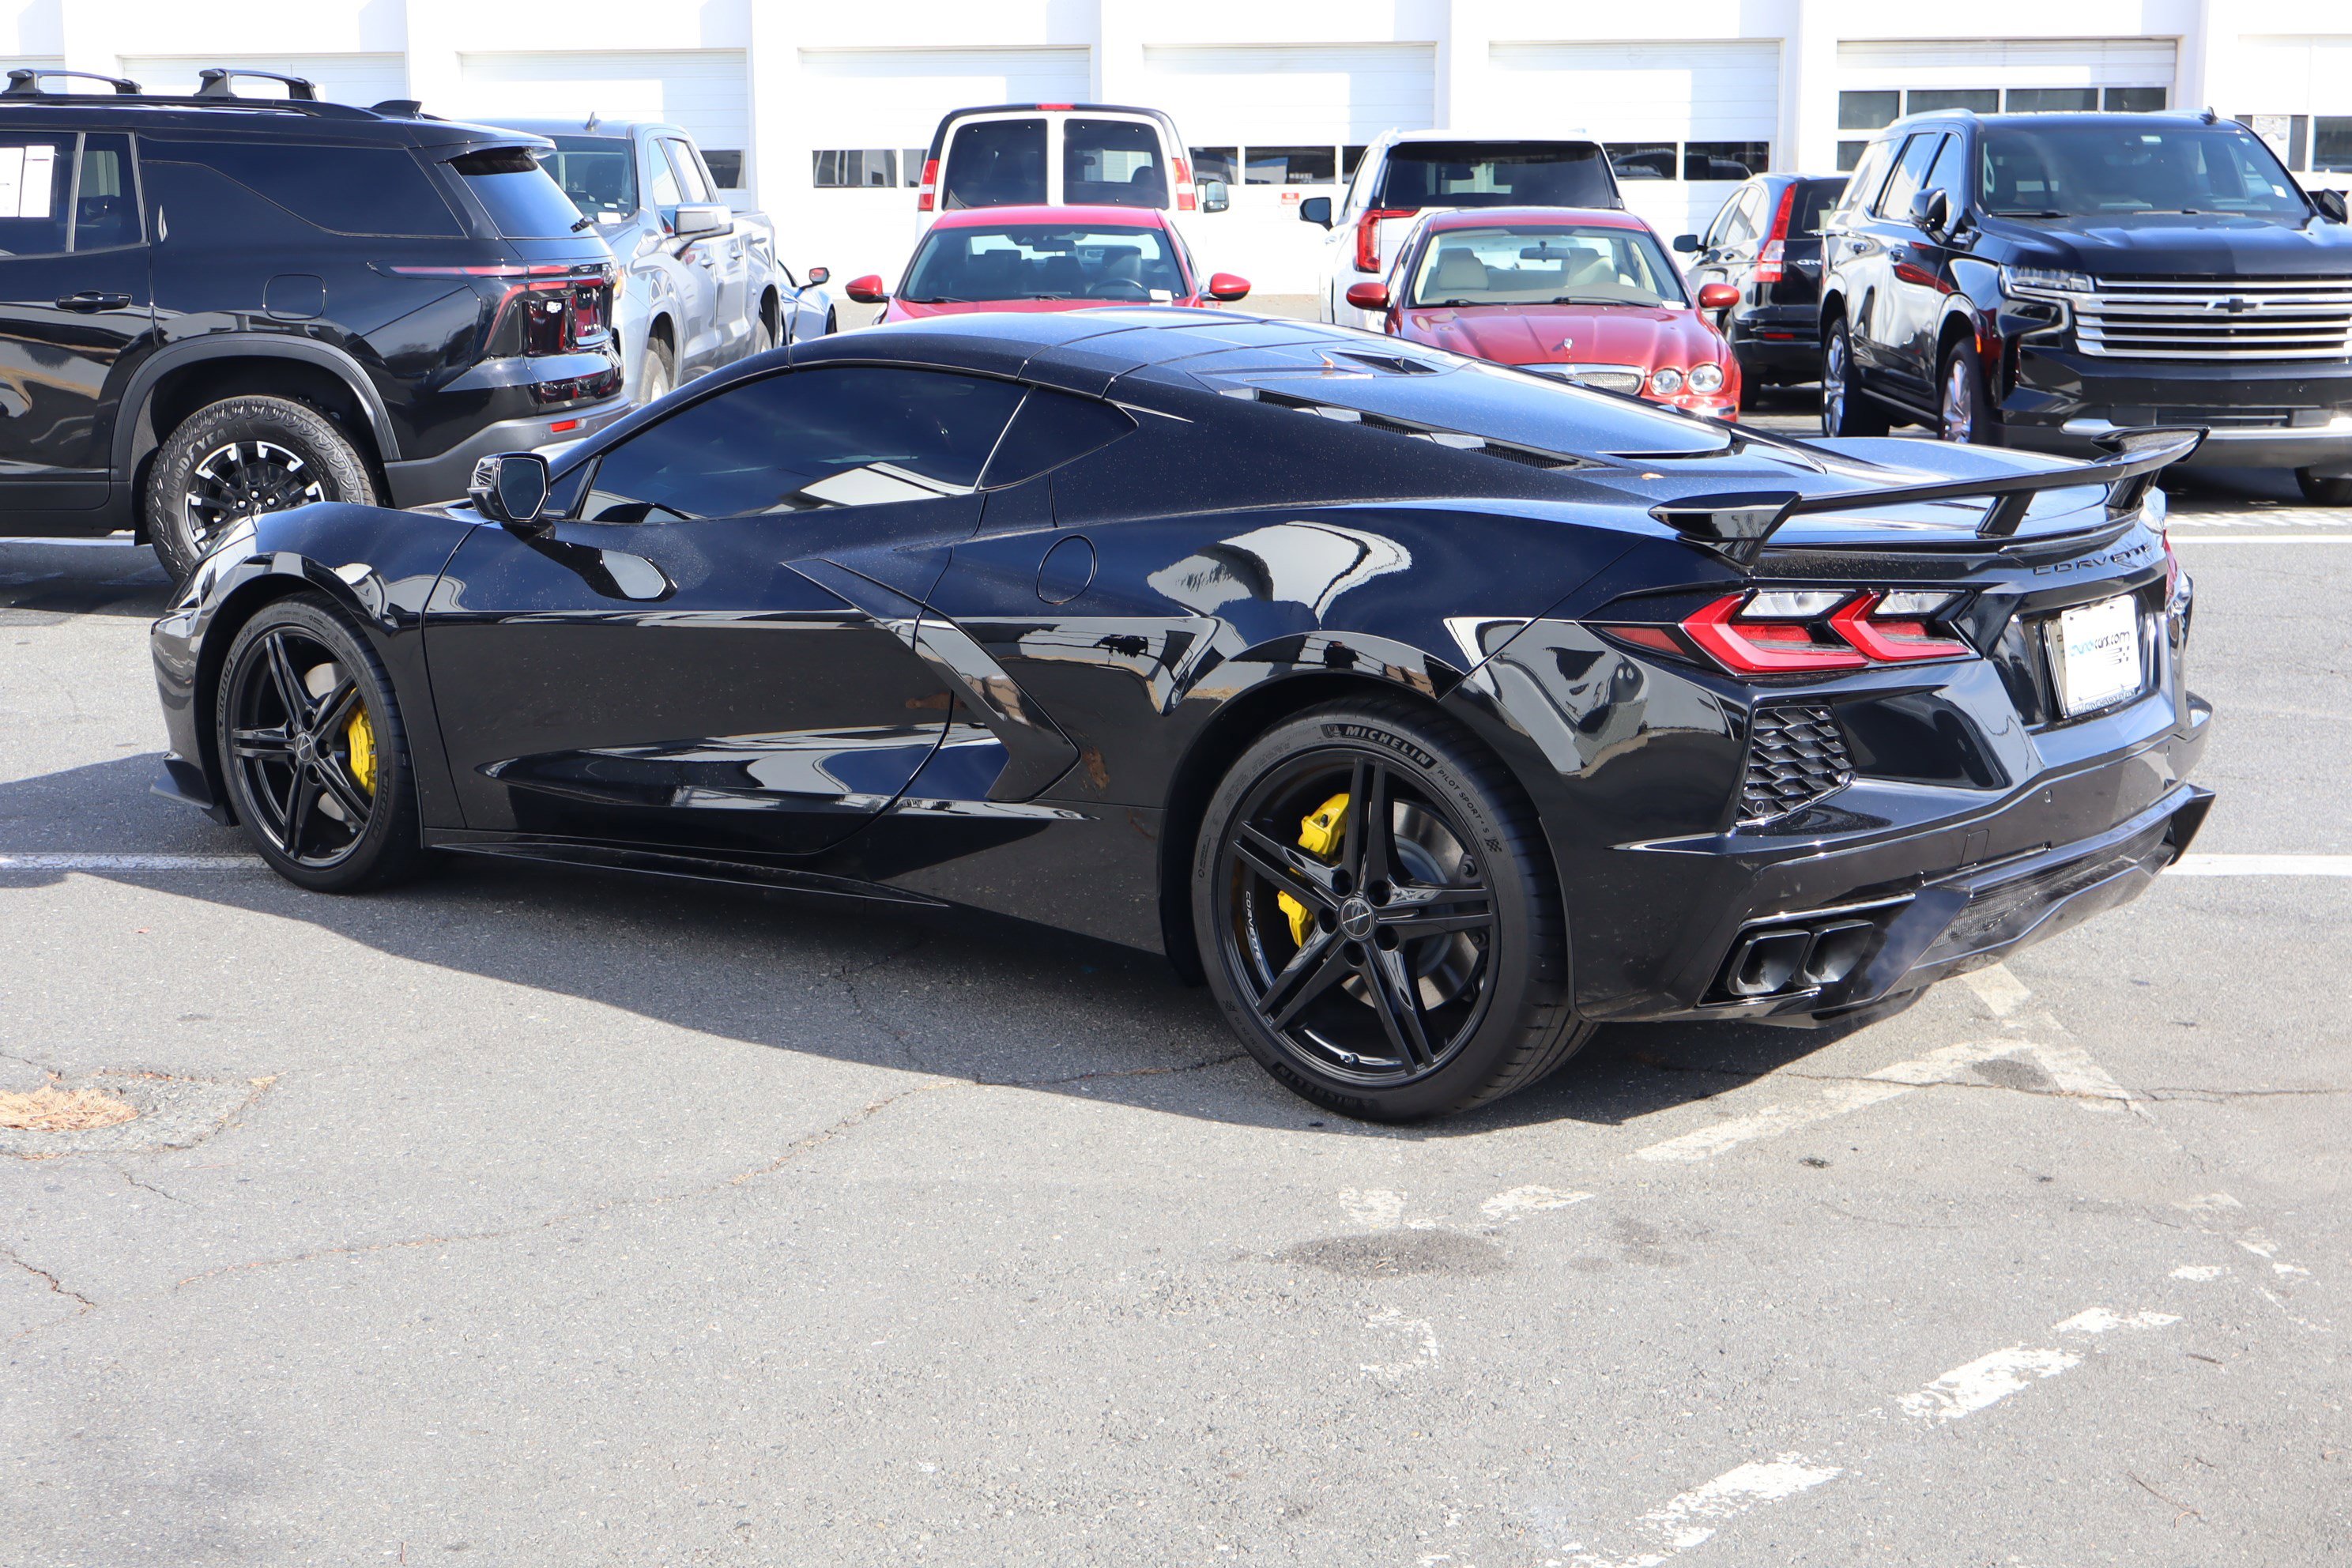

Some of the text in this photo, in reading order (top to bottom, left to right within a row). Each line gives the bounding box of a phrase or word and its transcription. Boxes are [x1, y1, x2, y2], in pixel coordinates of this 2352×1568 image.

[2033, 542, 2153, 575] CORVETTE
[1344, 725, 1432, 767] MICHELIN
[1437, 769, 1460, 791] PILOT
[1459, 792, 1482, 820] SPORT
[1246, 891, 1263, 960] CORVETTE
